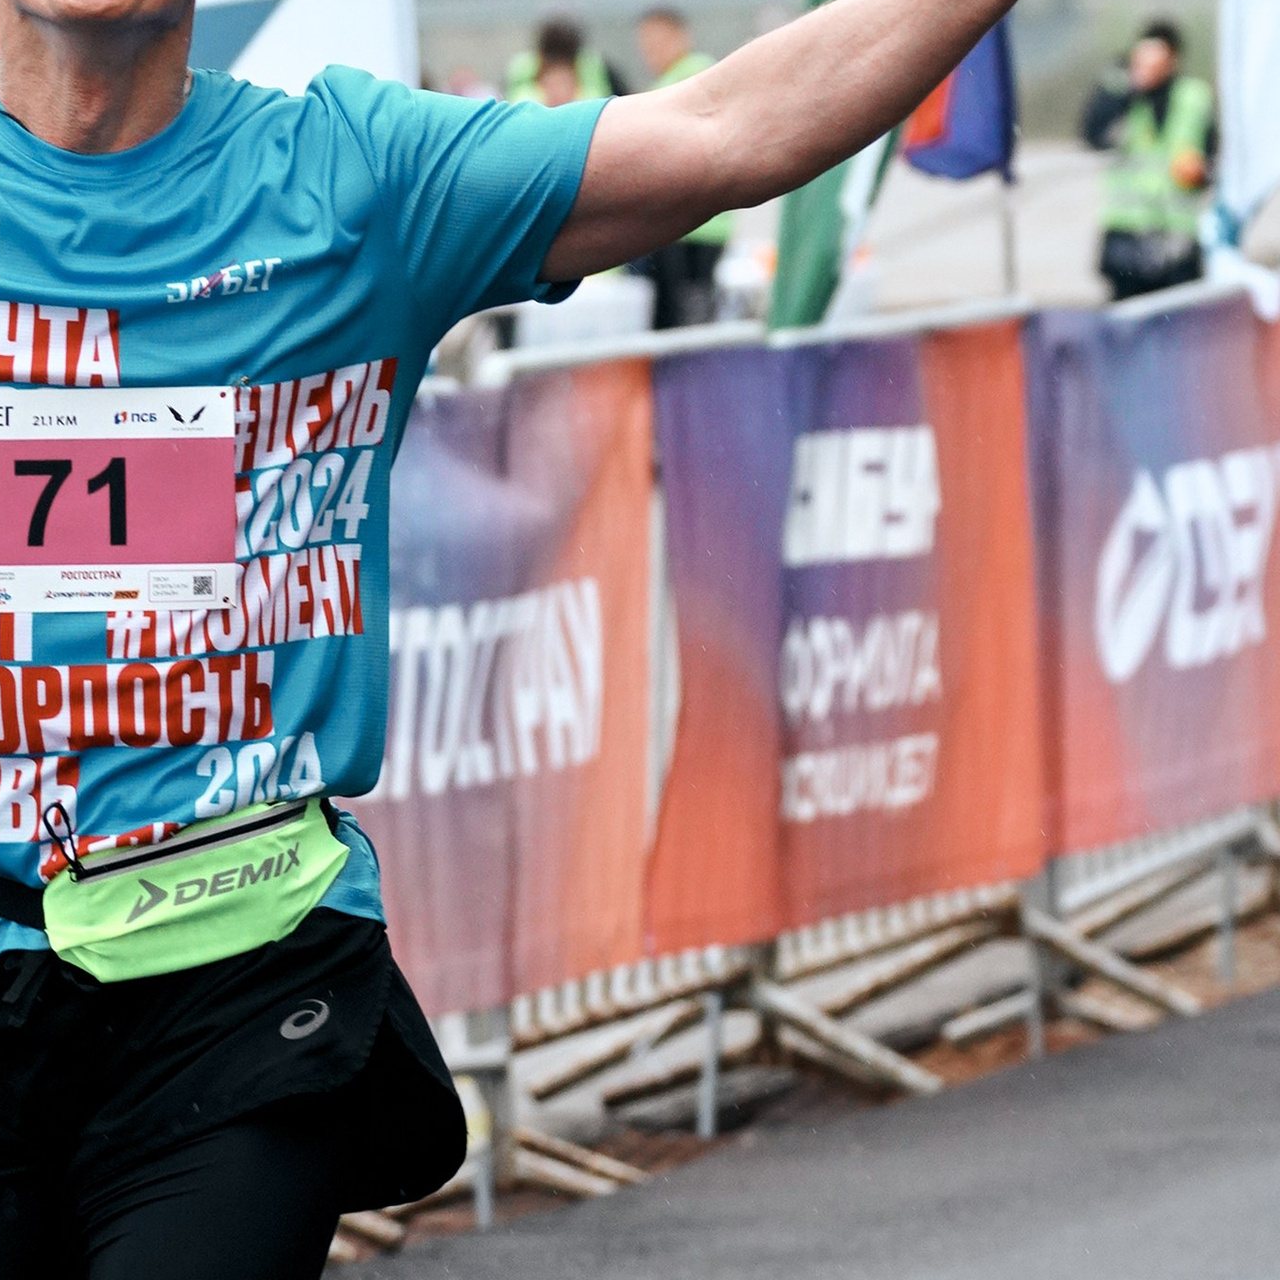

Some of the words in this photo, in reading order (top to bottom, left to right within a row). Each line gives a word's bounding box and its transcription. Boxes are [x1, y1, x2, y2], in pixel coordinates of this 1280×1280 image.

[131, 413, 157, 423] ПСБ
[14, 456, 128, 547] 71
[249, 450, 374, 558] 2024
[174, 842, 302, 907] DEMIX
